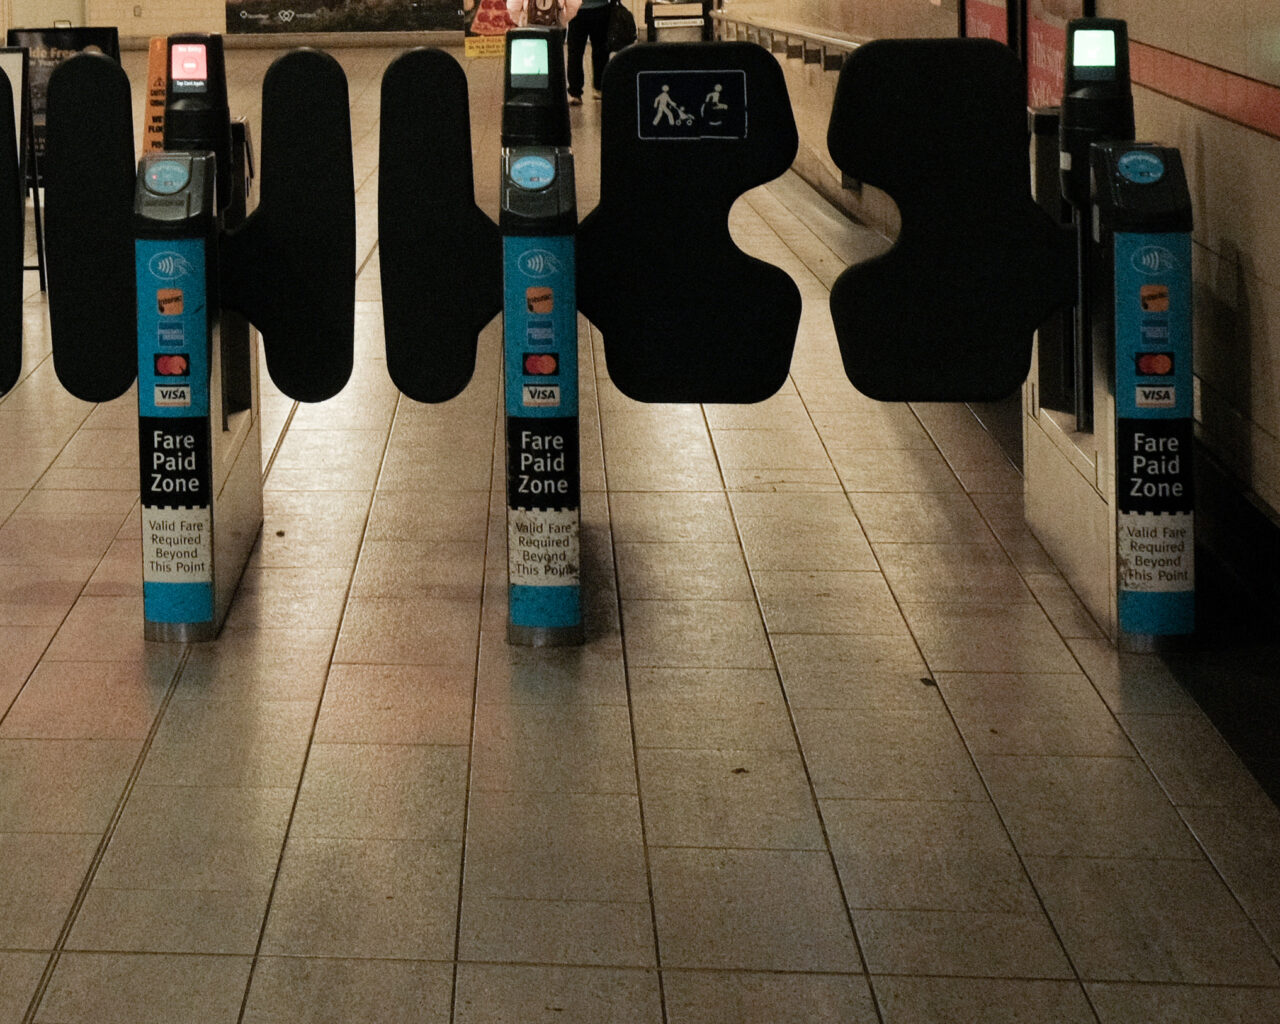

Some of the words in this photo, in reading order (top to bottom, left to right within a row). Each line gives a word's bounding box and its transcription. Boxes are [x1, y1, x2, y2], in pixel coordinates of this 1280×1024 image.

[160, 390, 186, 399] VISA
[529, 390, 556, 399] VISA
[1142, 390, 1171, 400] VISA
[153, 430, 195, 449] Fare
[521, 431, 564, 450] Fare
[1134, 433, 1179, 452] Fare
[153, 451, 196, 471] Paid
[521, 453, 565, 472] Paid
[1133, 455, 1180, 475] Paid
[150, 473, 200, 492] Zone
[518, 475, 568, 494] Zone
[1130, 478, 1184, 497] Zone
[149, 520, 175, 531] Valid
[180, 521, 204, 531] Fare
[516, 522, 543, 533] Valid
[548, 523, 571, 533] Fare
[1127, 526, 1158, 538] Valid
[1163, 527, 1186, 538] Fare
[151, 534, 201, 546] Required
[518, 536, 570, 549] Required
[155, 548, 198, 560] Beyond
[1130, 541, 1185, 554] Required
[522, 550, 566, 563] Beyond
[1135, 556, 1181, 568] Beyond
[149, 560, 172, 572] This
[176, 561, 205, 572] Point
[516, 563, 539, 575] This
[544, 564, 572, 576] Point
[1127, 569, 1153, 581] This
[1158, 570, 1188, 581] Point
